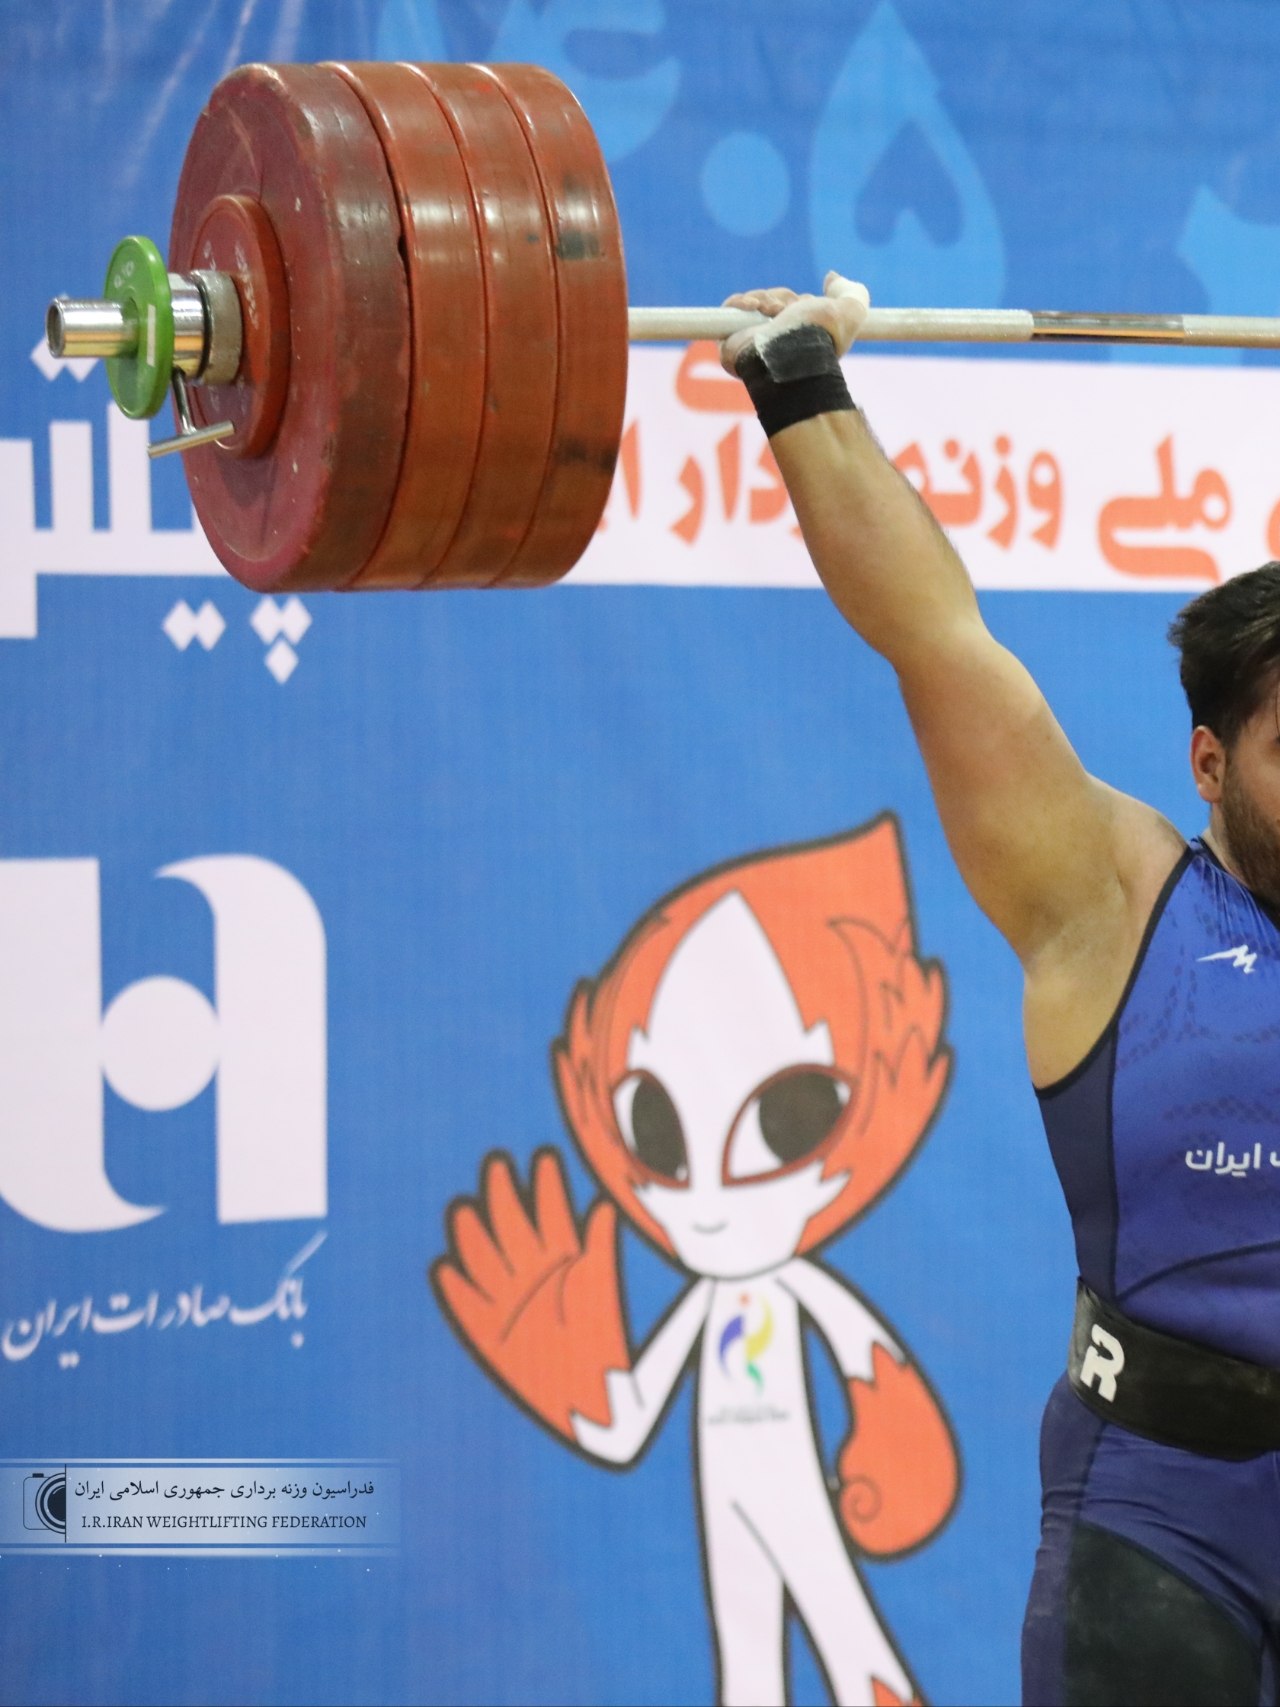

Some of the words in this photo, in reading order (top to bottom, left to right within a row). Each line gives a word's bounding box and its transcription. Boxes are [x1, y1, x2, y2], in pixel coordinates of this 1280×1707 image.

[1097, 434, 1231, 586] ملی
[1185, 1142, 1261, 1177] ایران
[92, 1284, 231, 1334] صادرات
[228, 1230, 328, 1348] بانک
[1, 1297, 93, 1369] ایران
